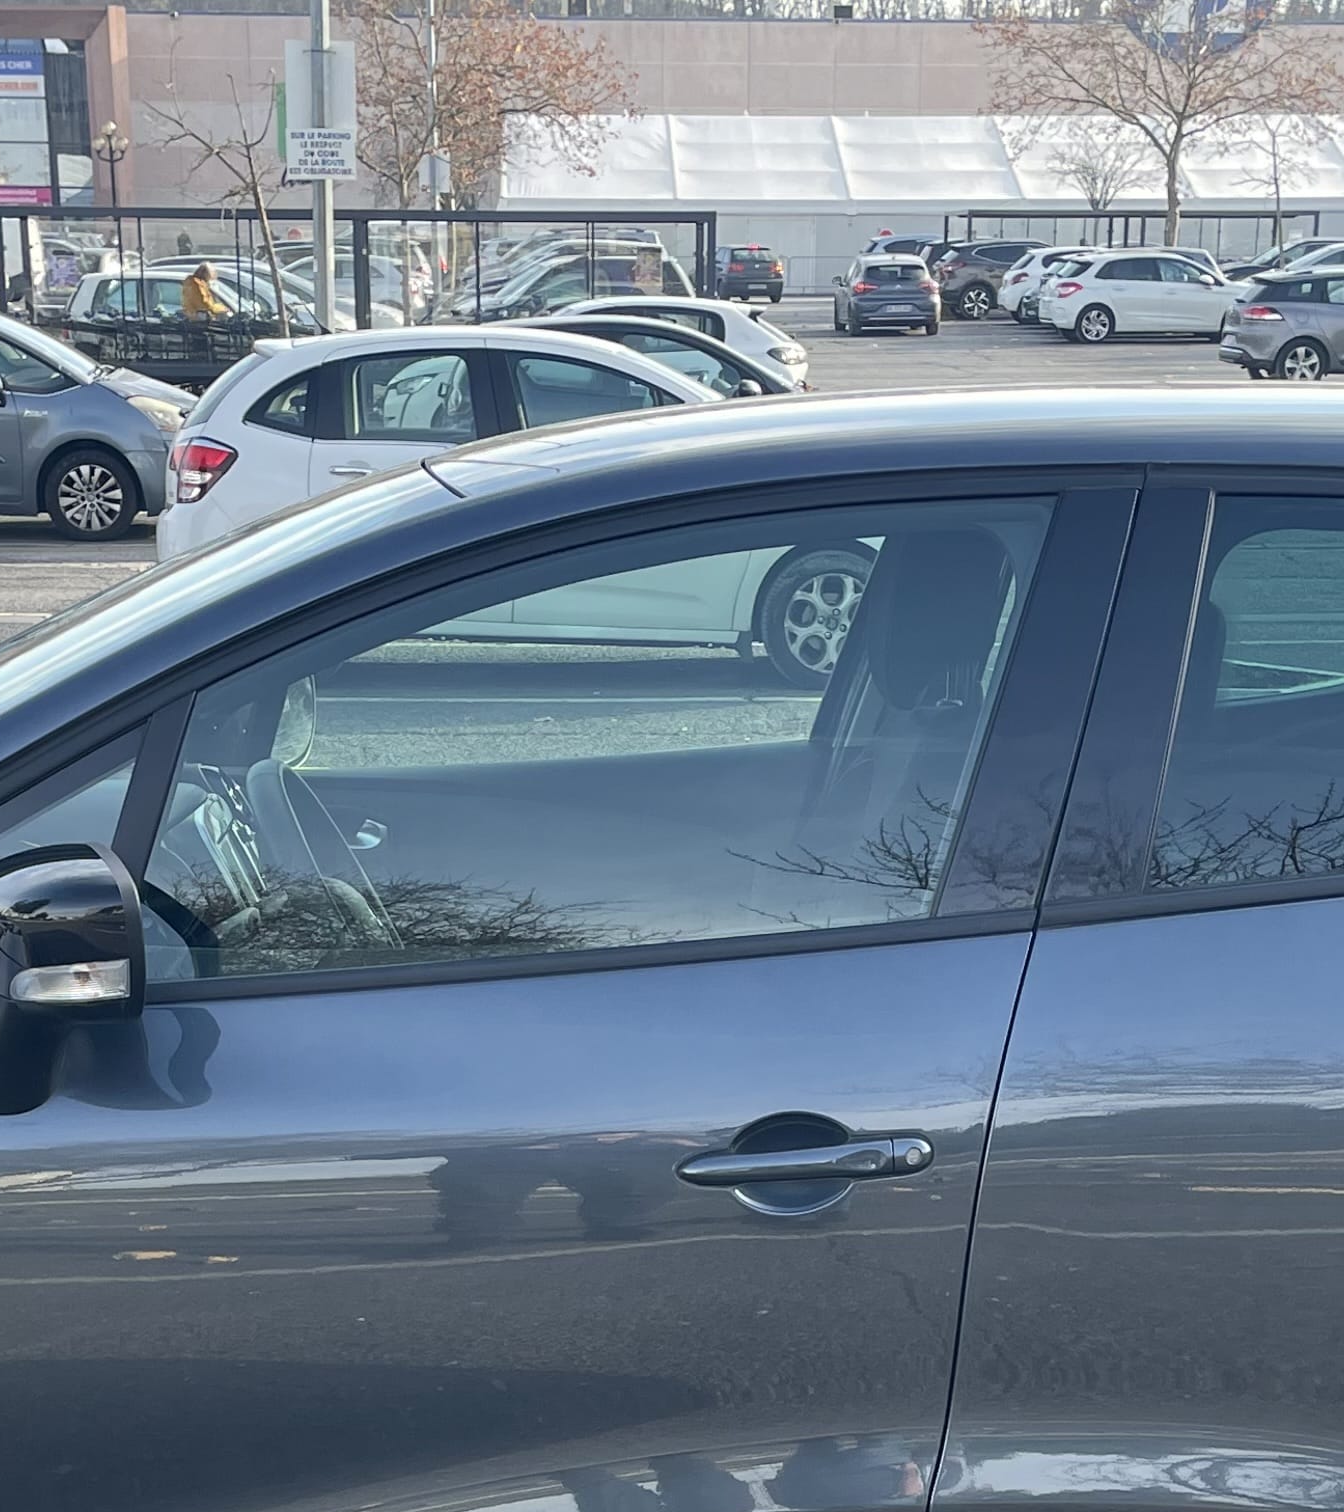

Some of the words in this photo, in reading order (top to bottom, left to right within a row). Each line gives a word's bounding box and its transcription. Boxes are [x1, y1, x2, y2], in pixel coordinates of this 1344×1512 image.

[290, 132, 305, 140] SUR
[307, 132, 315, 140] LE
[317, 132, 351, 140] PARKING
[321, 159, 345, 167] ROUTE
